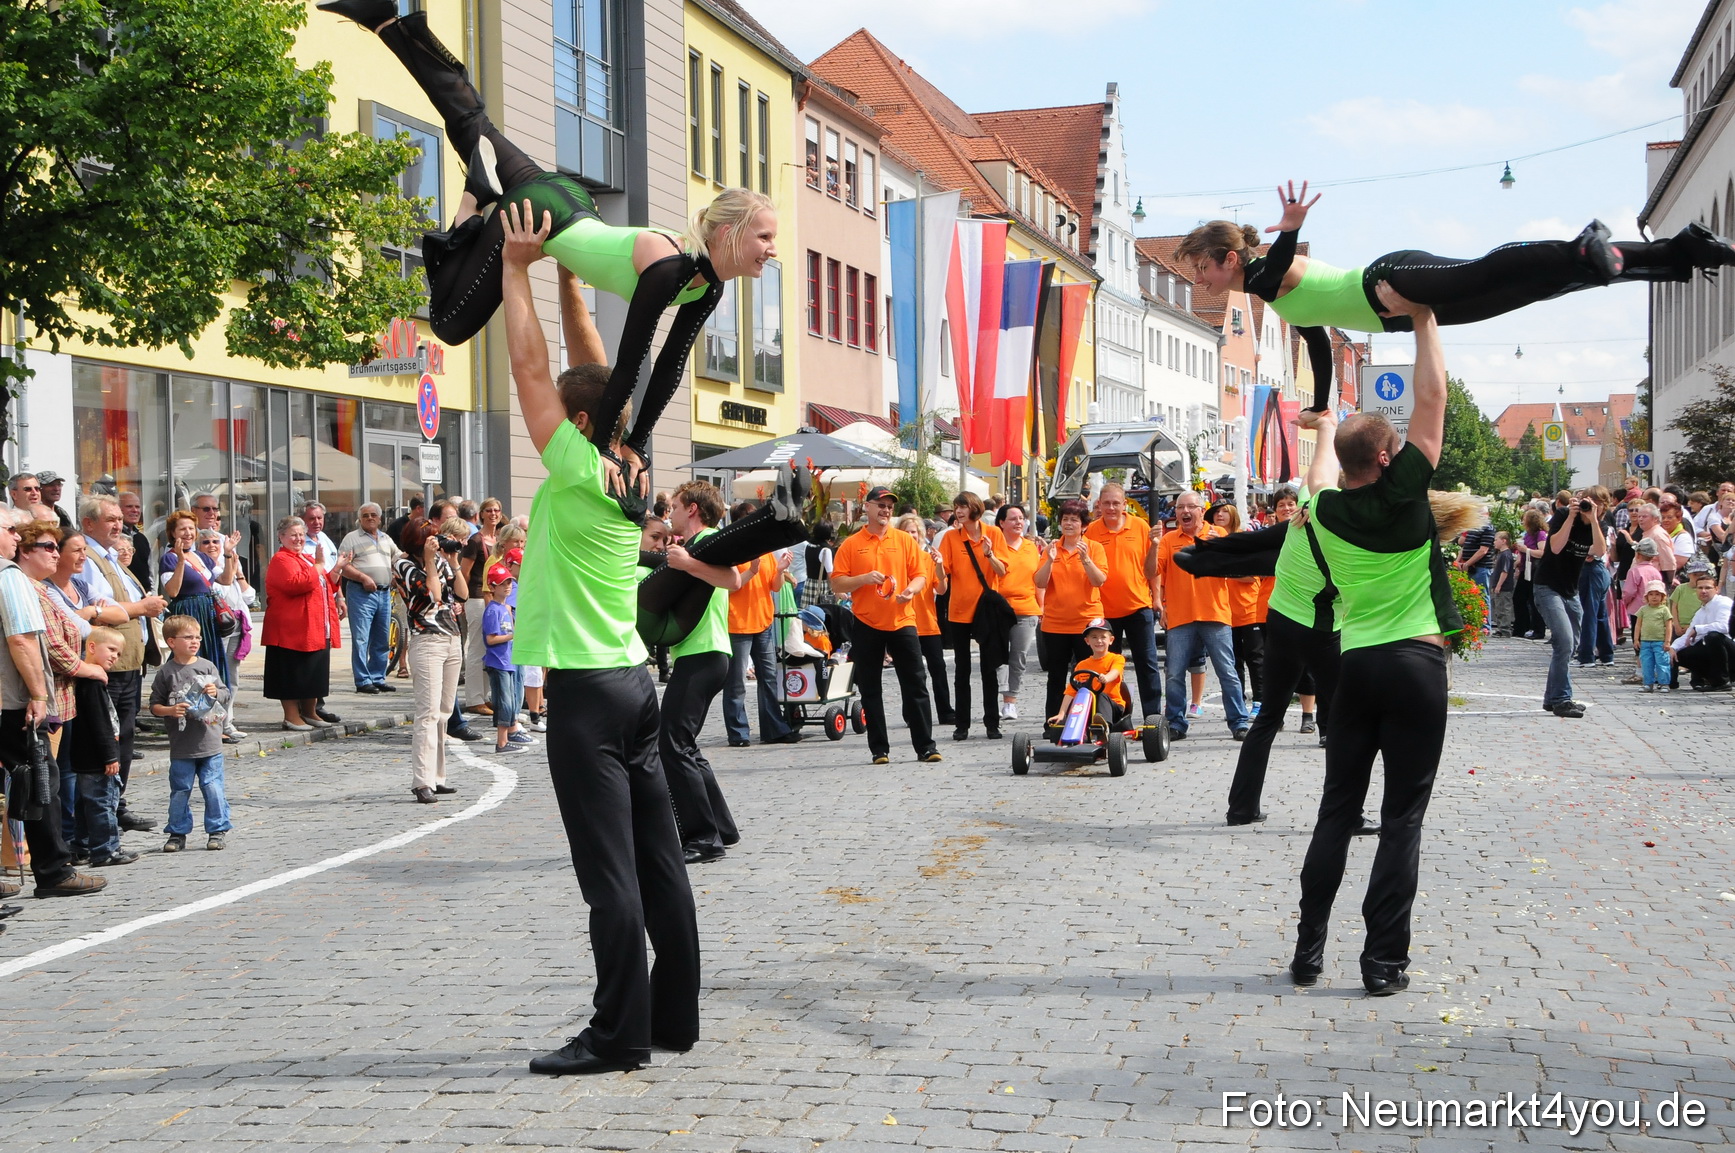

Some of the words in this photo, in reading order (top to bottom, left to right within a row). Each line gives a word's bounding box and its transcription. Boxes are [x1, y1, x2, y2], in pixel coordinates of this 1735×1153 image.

[350, 361, 417, 375] Brunnwirtsgasse
[1376, 405, 1404, 415] ZONE
[1070, 716, 1078, 729] 1
